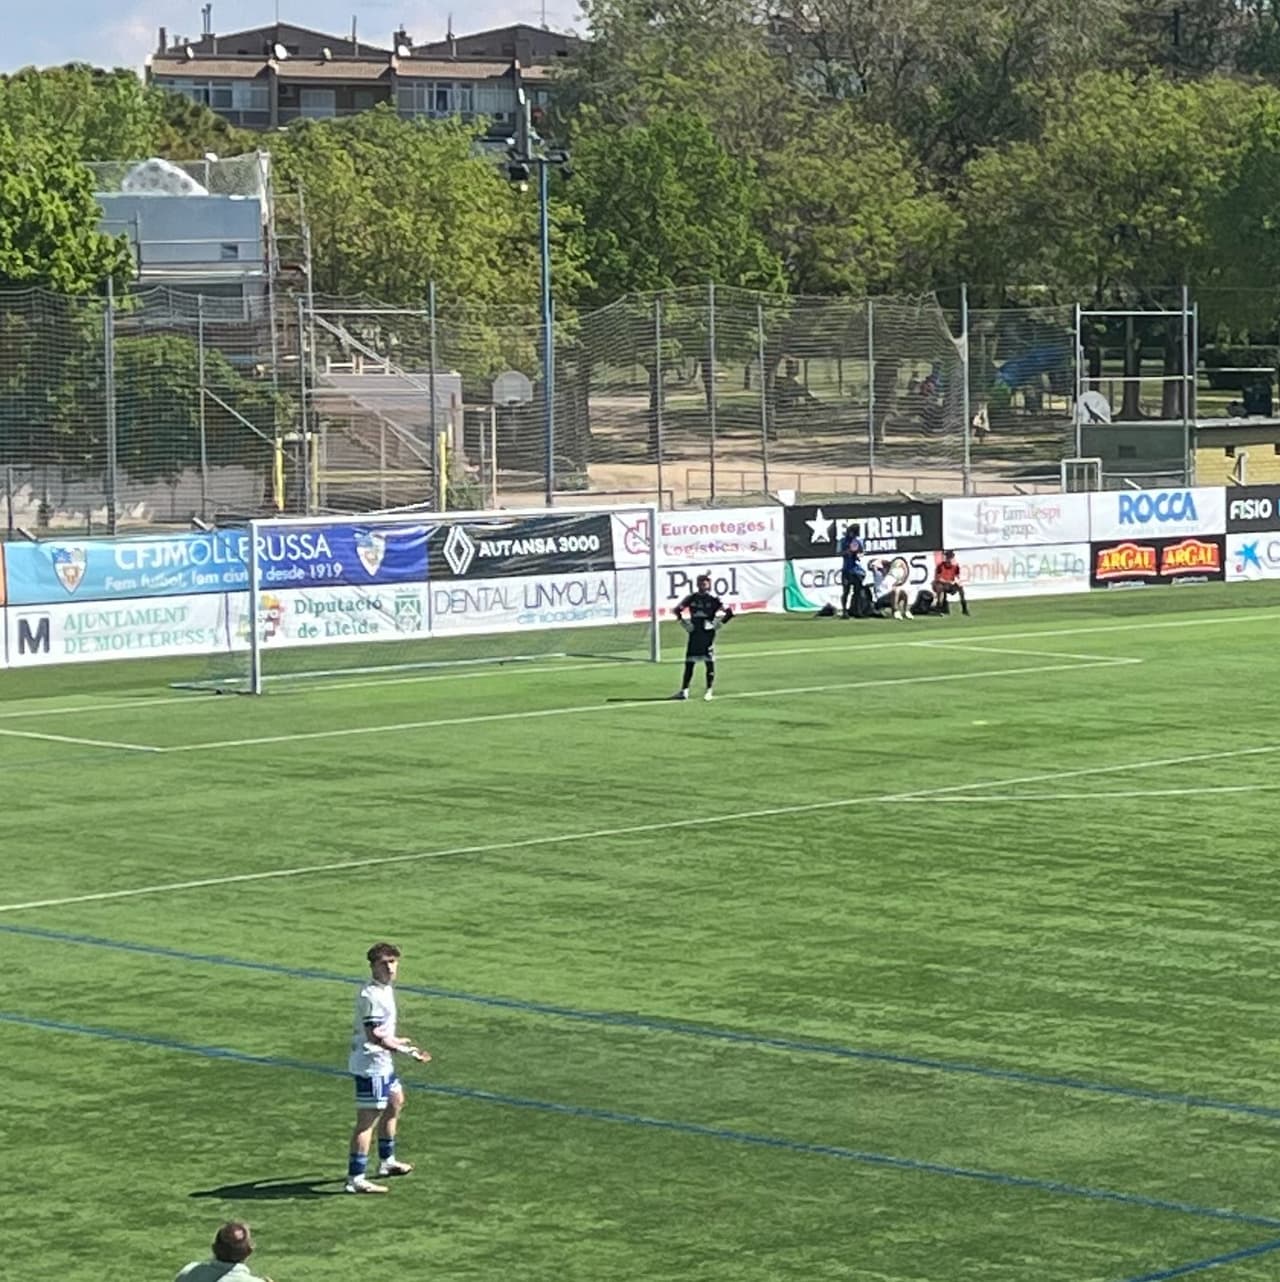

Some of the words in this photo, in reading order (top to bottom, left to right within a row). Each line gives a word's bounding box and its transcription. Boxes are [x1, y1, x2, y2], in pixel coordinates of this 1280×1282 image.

[1118, 491, 1199, 524] ROCCA
[1230, 498, 1273, 520] FISIO
[661, 520, 766, 536] Euroneteges
[836, 514, 924, 540] ETRELLA
[478, 538, 557, 558] AUTANSA
[559, 534, 600, 552] 3000
[1166, 546, 1216, 567] ARGAL
[1102, 549, 1152, 570] ARGAL
[266, 565, 306, 581] desde
[310, 562, 343, 580] 1919
[434, 585, 520, 616] DENTAL
[524, 578, 610, 610] LINYOLA
[64, 606, 190, 634] AJUNTAMENT
[298, 622, 320, 639] de
[18, 618, 50, 654] M
[64, 636, 93, 655] DE
